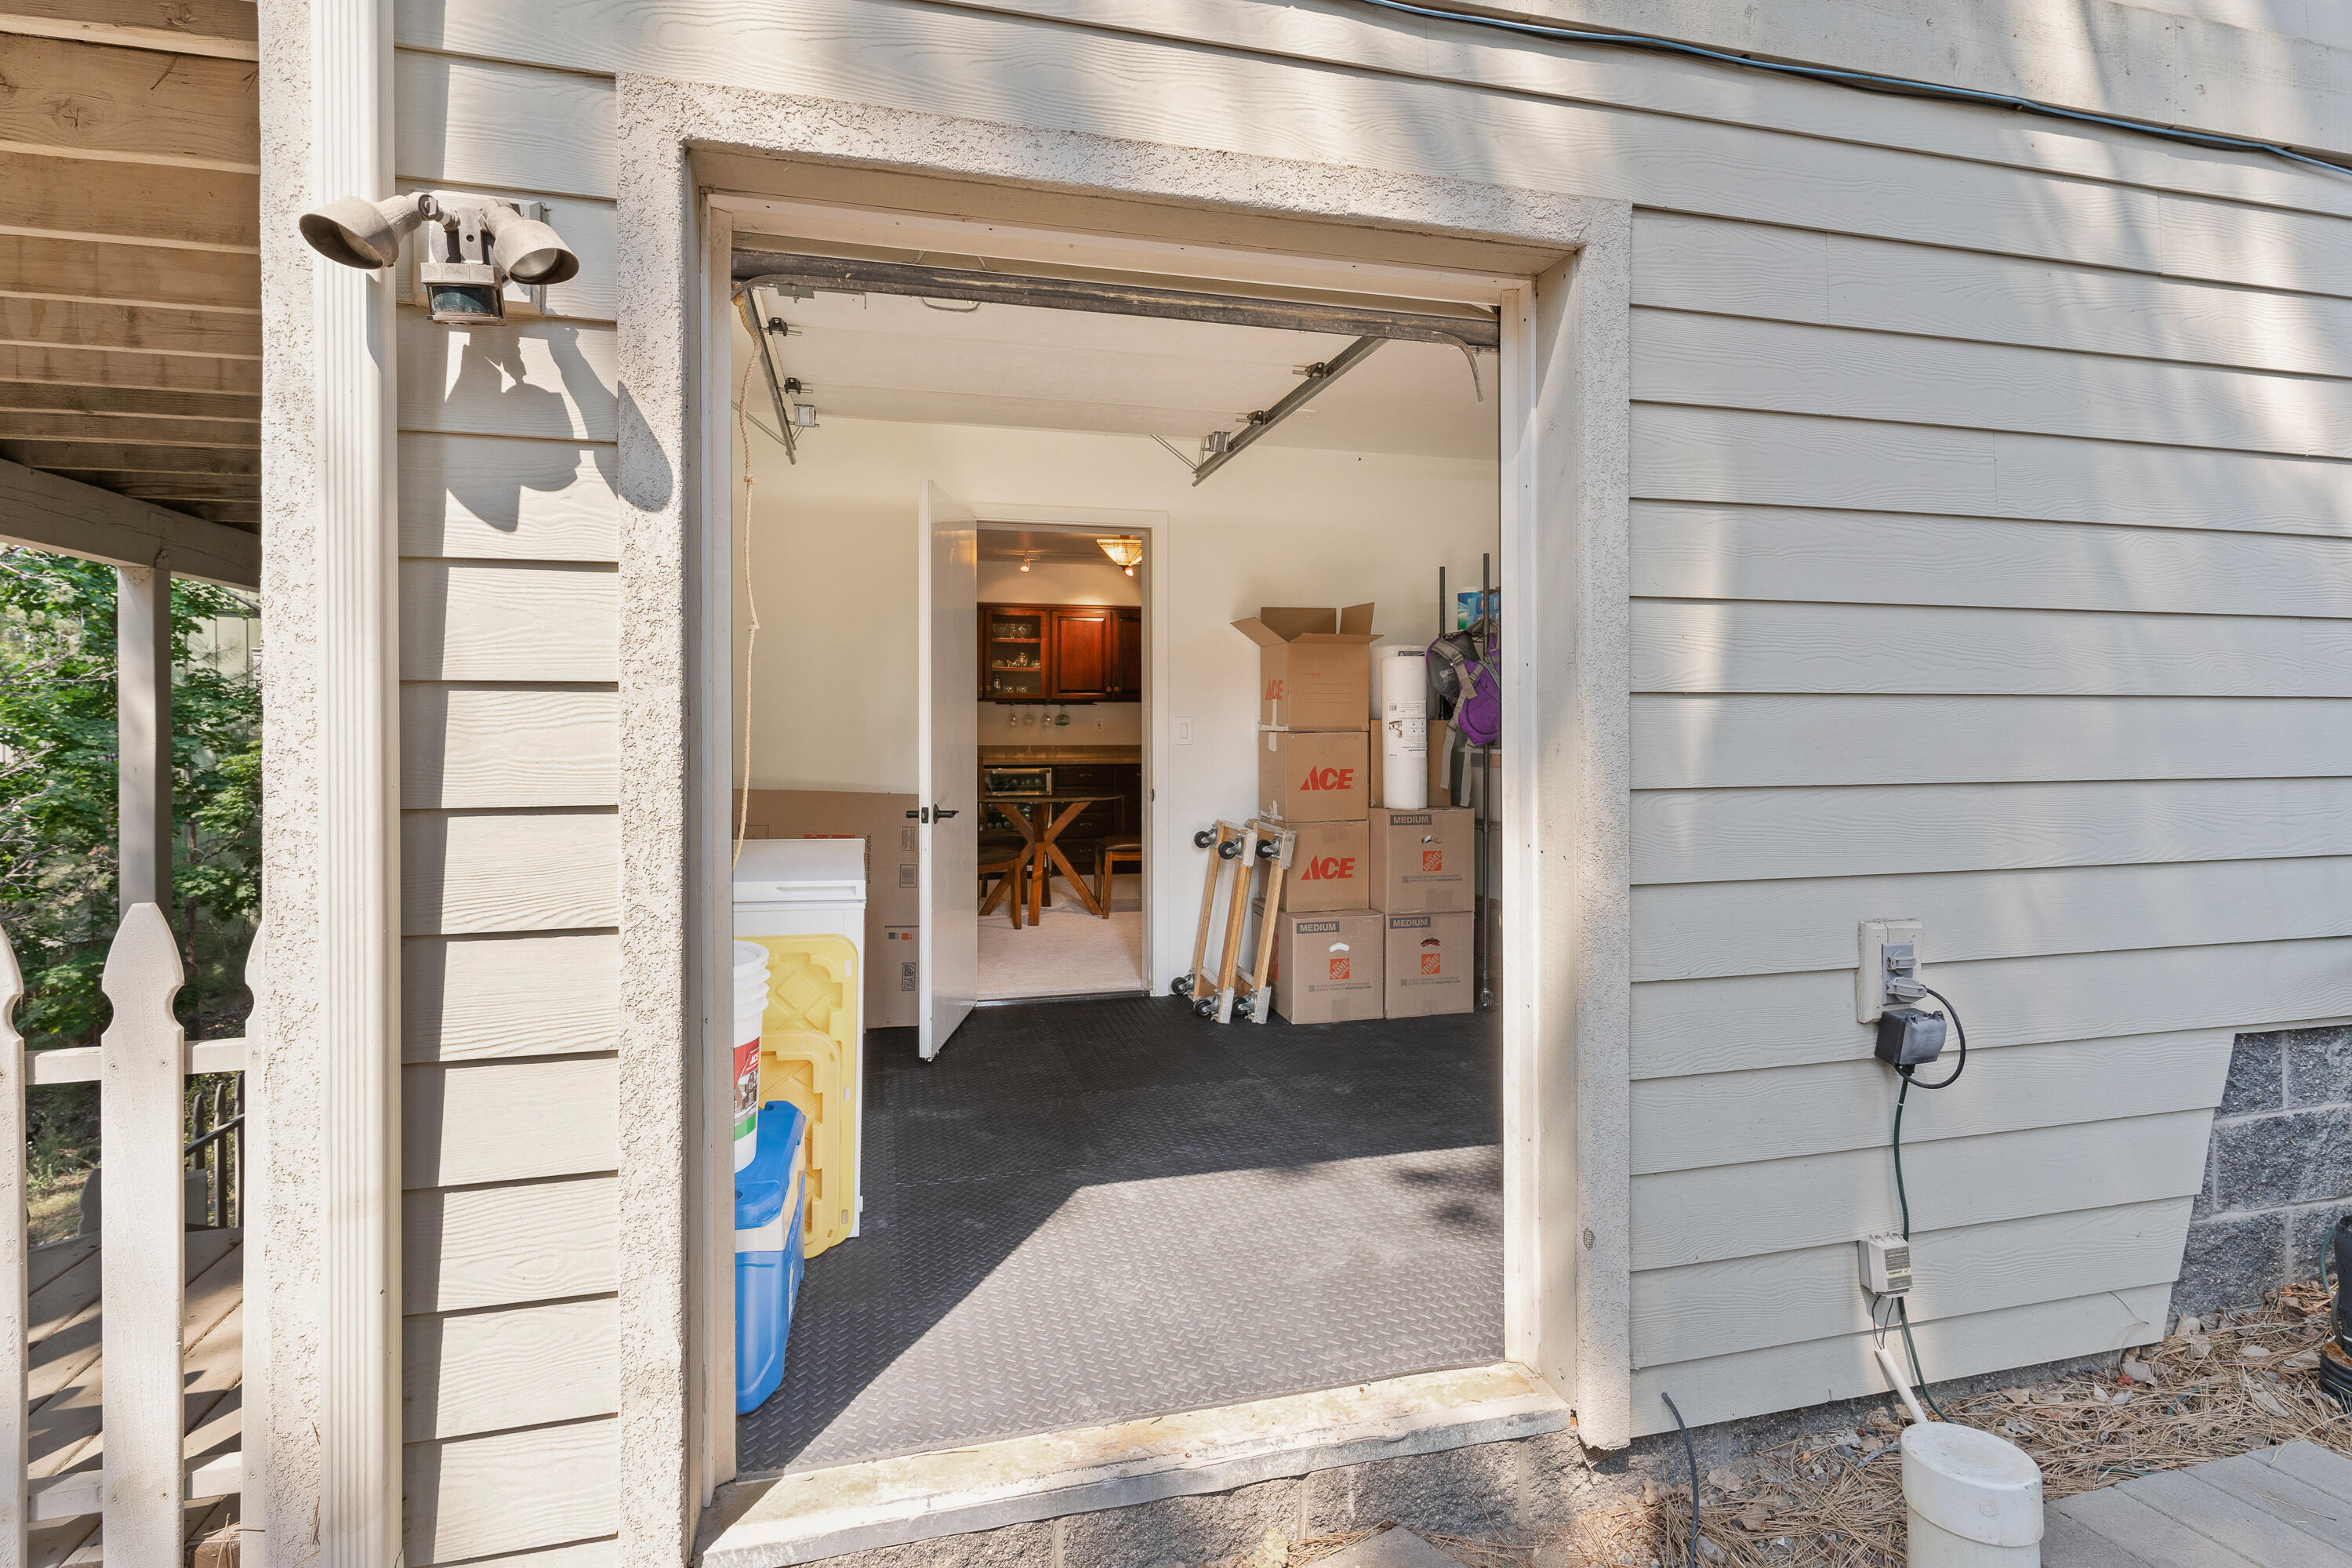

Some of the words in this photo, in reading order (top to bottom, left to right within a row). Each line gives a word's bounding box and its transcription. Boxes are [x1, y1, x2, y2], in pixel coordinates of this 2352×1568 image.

[1265, 677, 1283, 700] ACE
[1300, 765, 1355, 790] ACE
[1300, 854, 1356, 880] ACE
[1300, 924, 1336, 932] MEDIUM
[1393, 919, 1428, 927] MEDIUM
